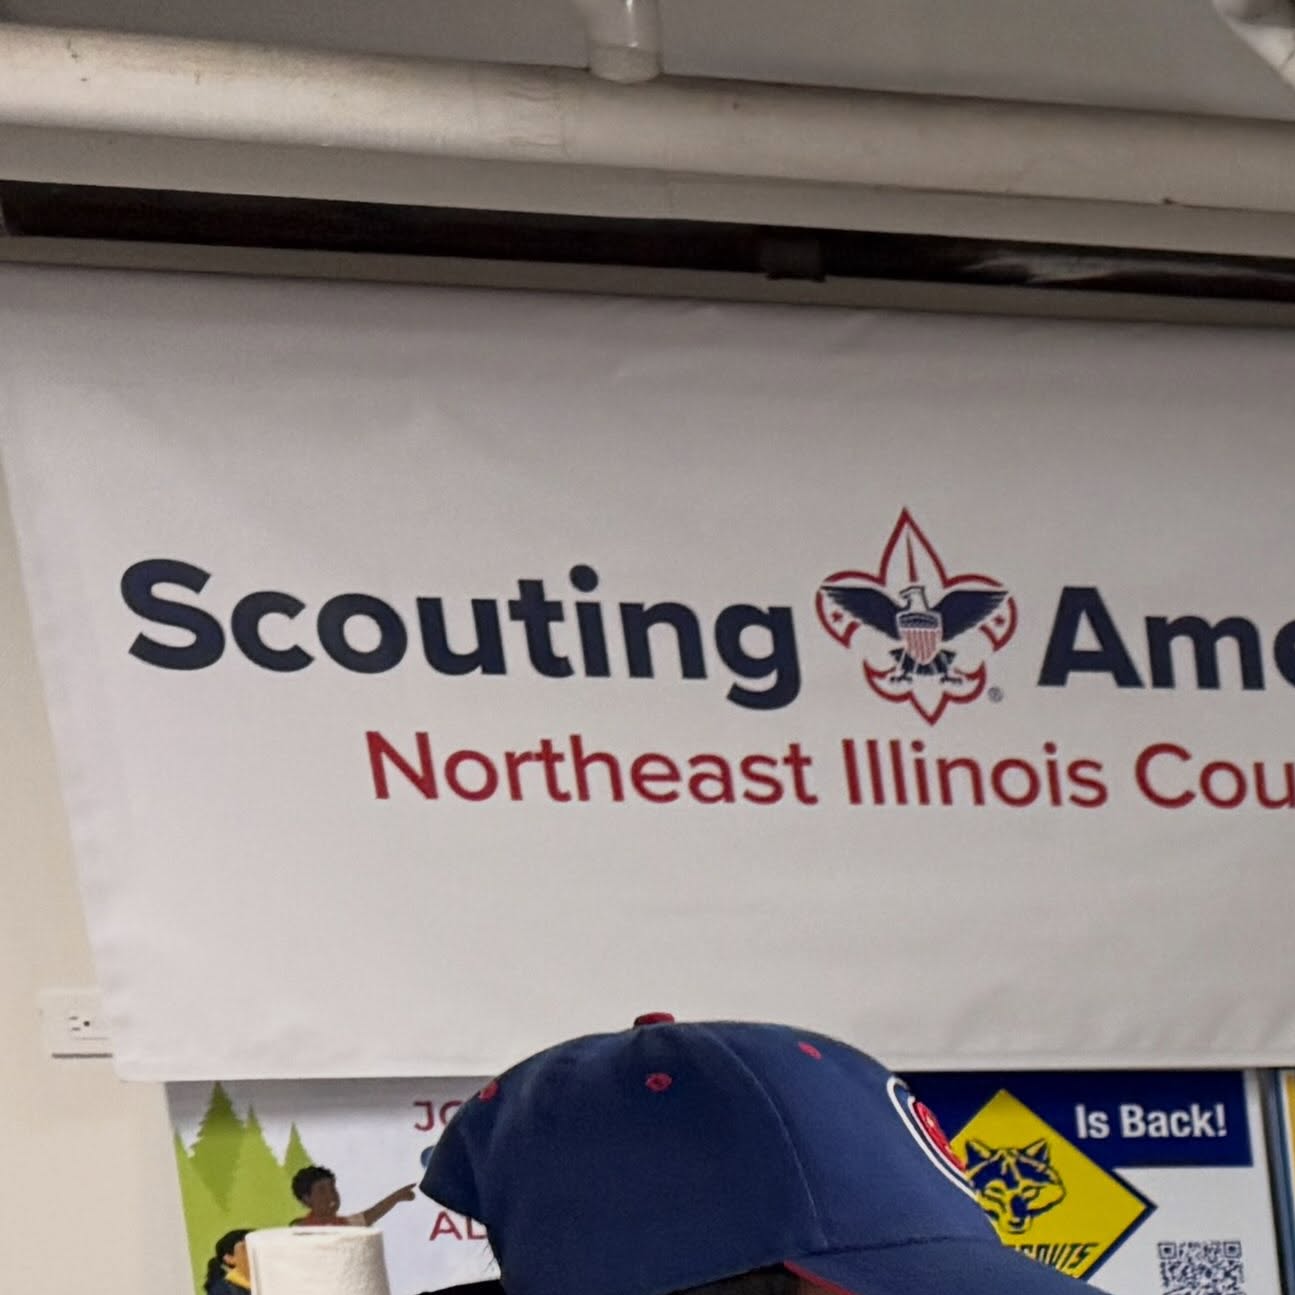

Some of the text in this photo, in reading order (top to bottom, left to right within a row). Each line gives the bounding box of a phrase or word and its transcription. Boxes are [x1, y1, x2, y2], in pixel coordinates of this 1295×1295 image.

[120, 558, 802, 711] Scouting
[366, 731, 818, 805] Northeast
[843, 739, 1107, 808] Illinois
[1074, 1102, 1228, 1140] Is Back!
